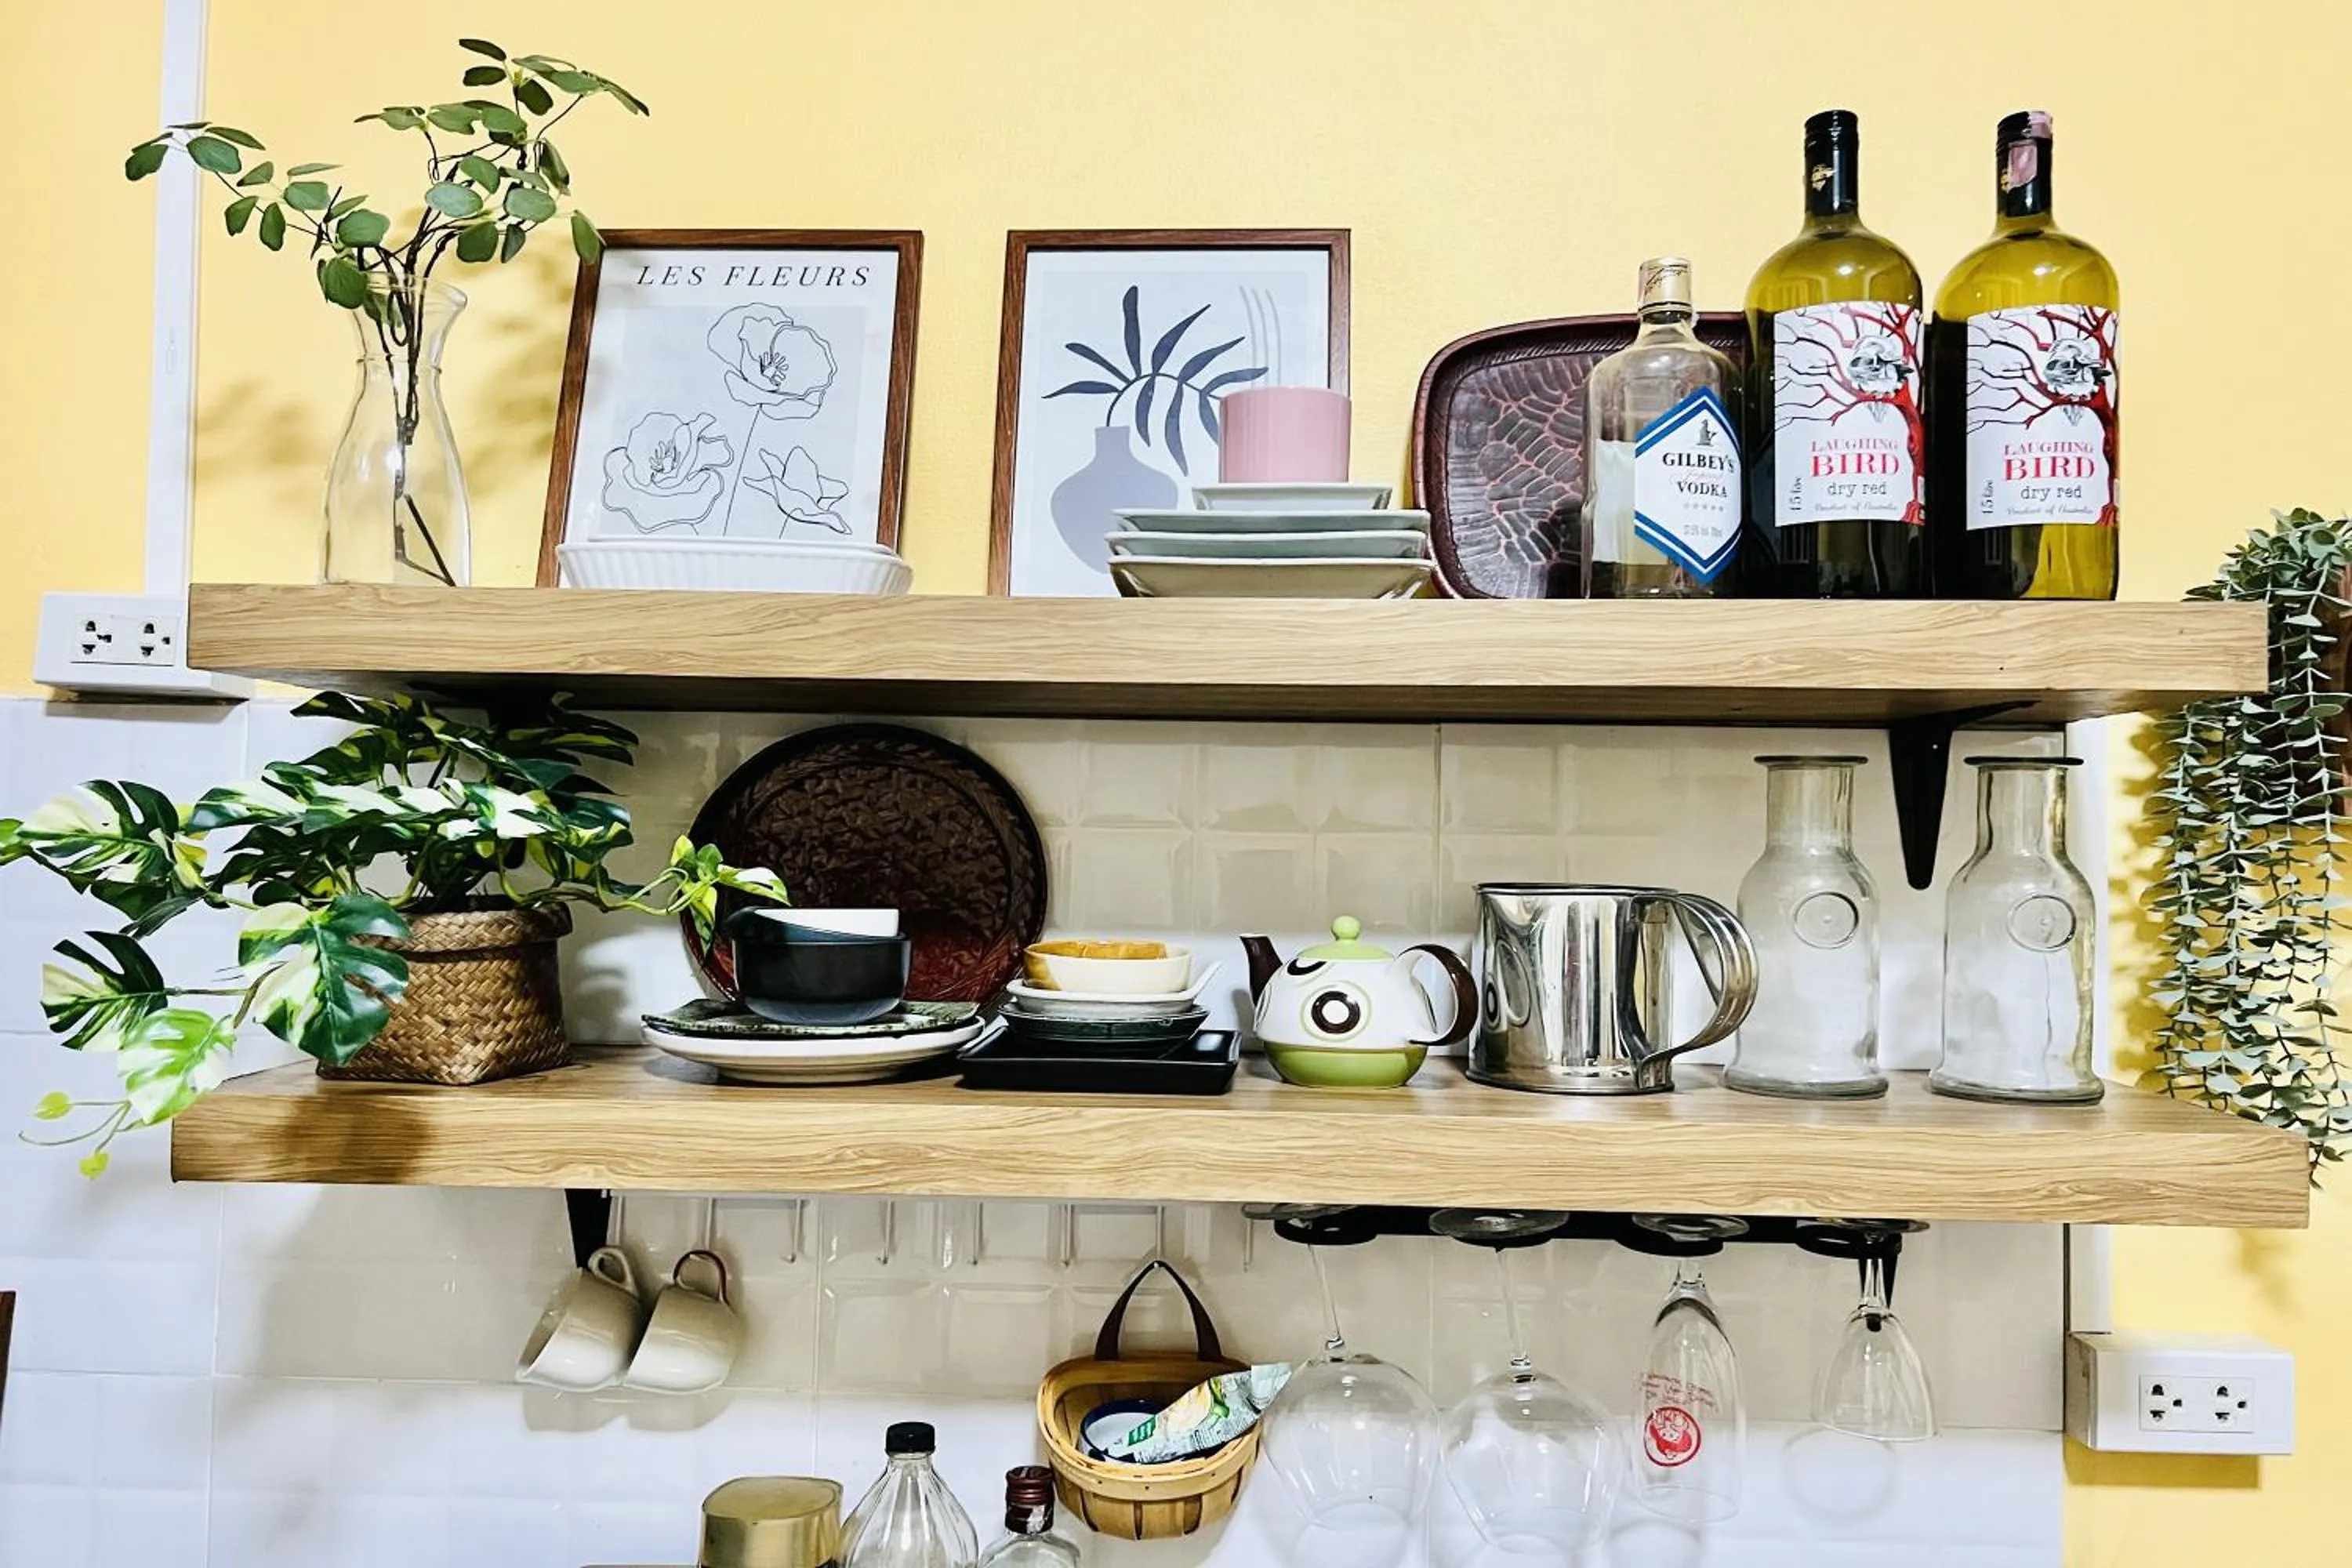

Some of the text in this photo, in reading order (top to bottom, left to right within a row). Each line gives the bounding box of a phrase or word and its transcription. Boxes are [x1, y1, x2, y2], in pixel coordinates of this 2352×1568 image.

[637, 265, 870, 286] LES FLEURS
[1811, 437, 1898, 452] LAUGHING
[2004, 441, 2094, 456] LAUGHING
[1662, 452, 1735, 474] GILBEY'S
[1811, 453, 1900, 477] BIRD
[2004, 456, 2095, 481] BIRD
[1676, 480, 1728, 499] VODKA
[1828, 482, 1887, 498] dry red
[2020, 485, 2082, 501] dry red
